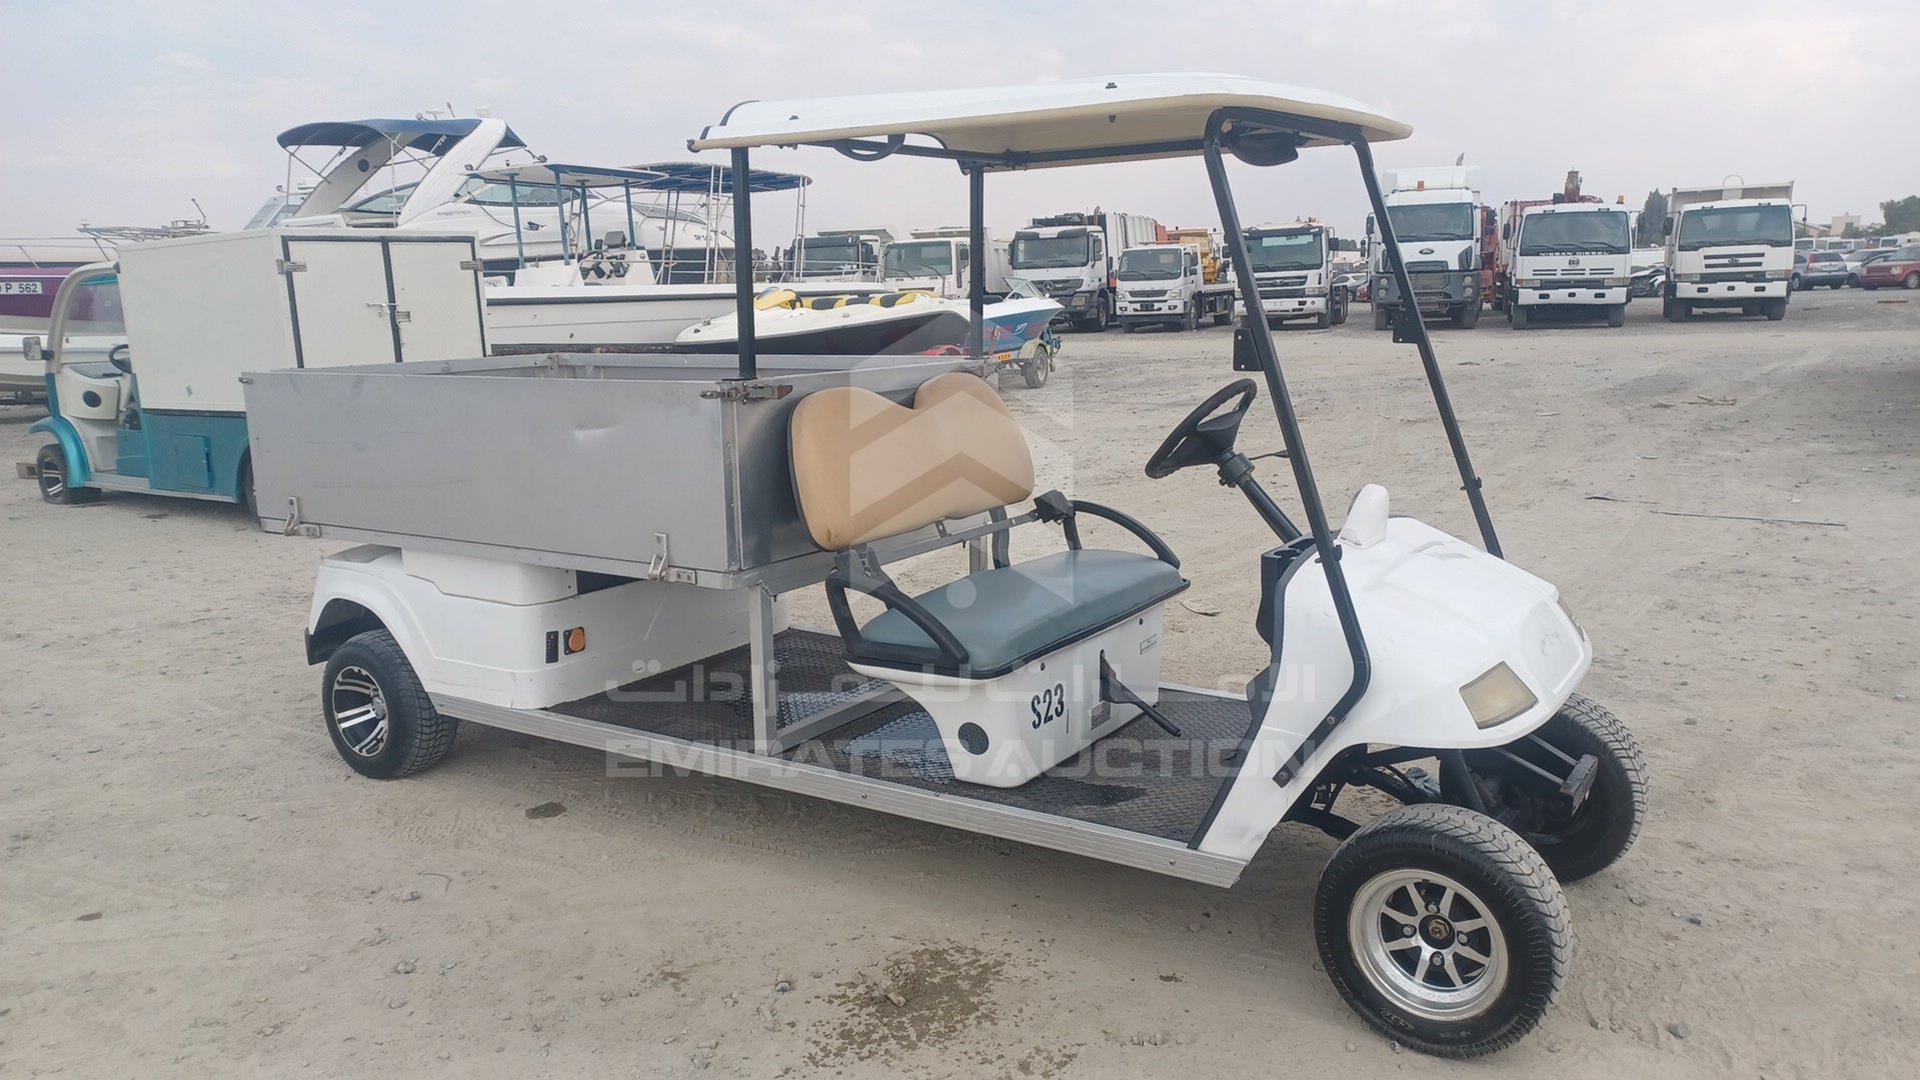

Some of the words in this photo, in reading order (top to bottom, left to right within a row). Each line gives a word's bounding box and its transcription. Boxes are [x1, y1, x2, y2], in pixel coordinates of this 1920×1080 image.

[5, 283, 12, 292] P
[18, 283, 37, 293] 562
[1030, 683, 1065, 730] S23
